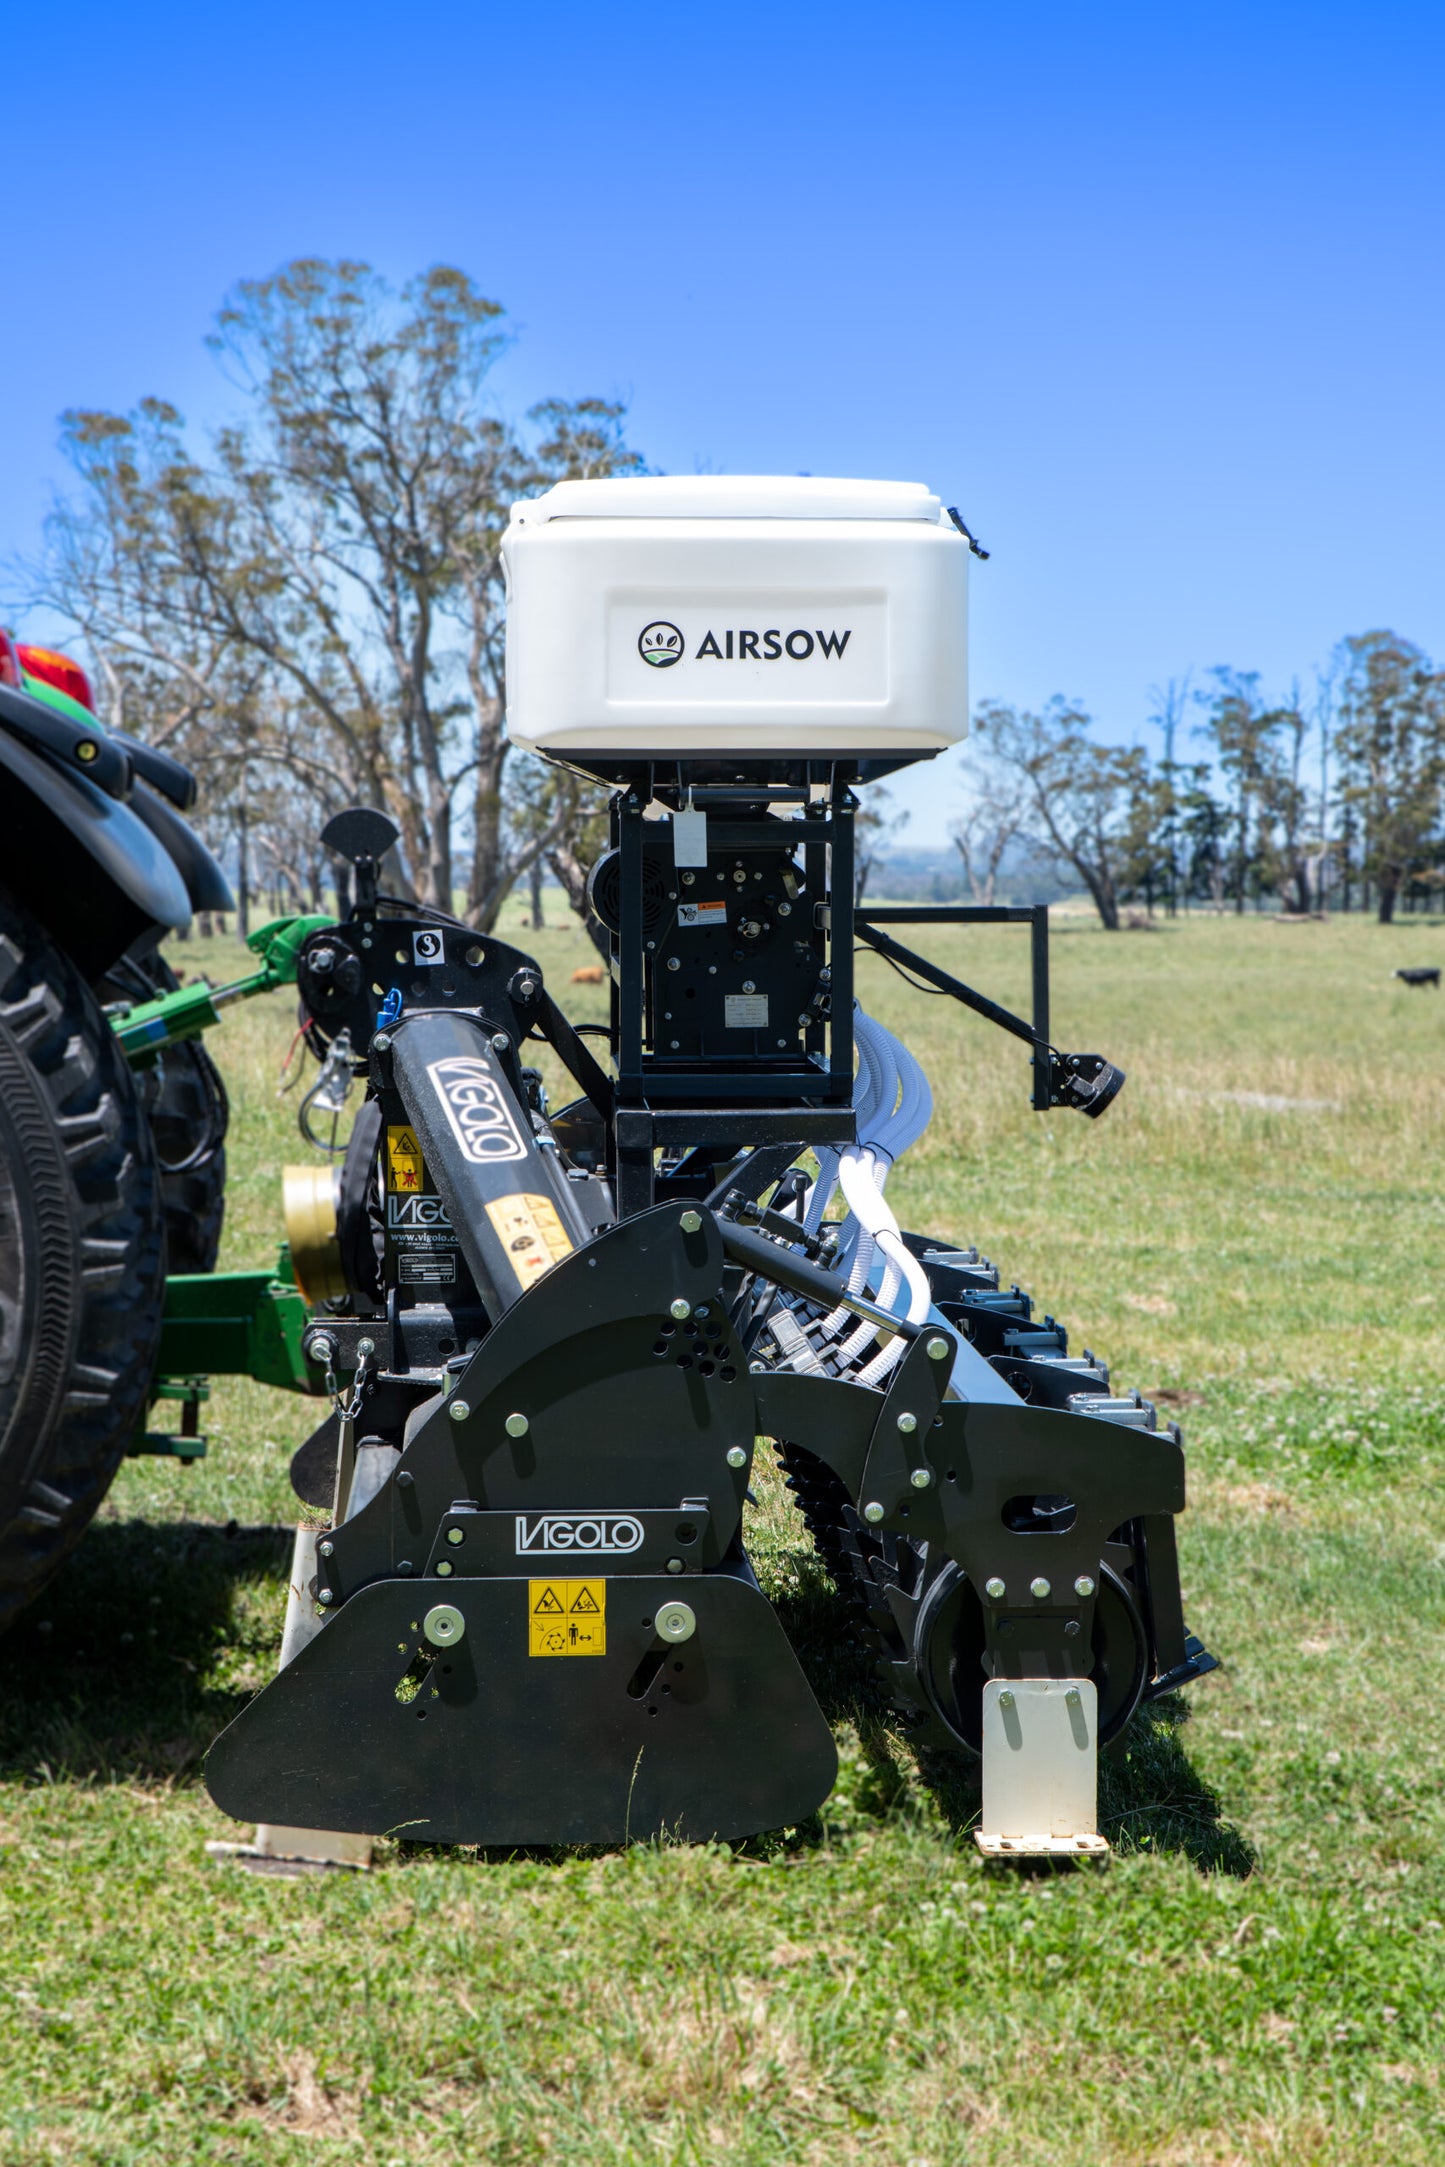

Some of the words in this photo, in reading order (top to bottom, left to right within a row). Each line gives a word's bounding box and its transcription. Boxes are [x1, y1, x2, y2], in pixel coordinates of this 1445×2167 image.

[695, 629, 852, 660] AIRSOW
[426, 1057, 528, 1164] VIGOLO
[388, 1195, 453, 1228] VIG
[515, 1515, 645, 1555] VIGOLO
